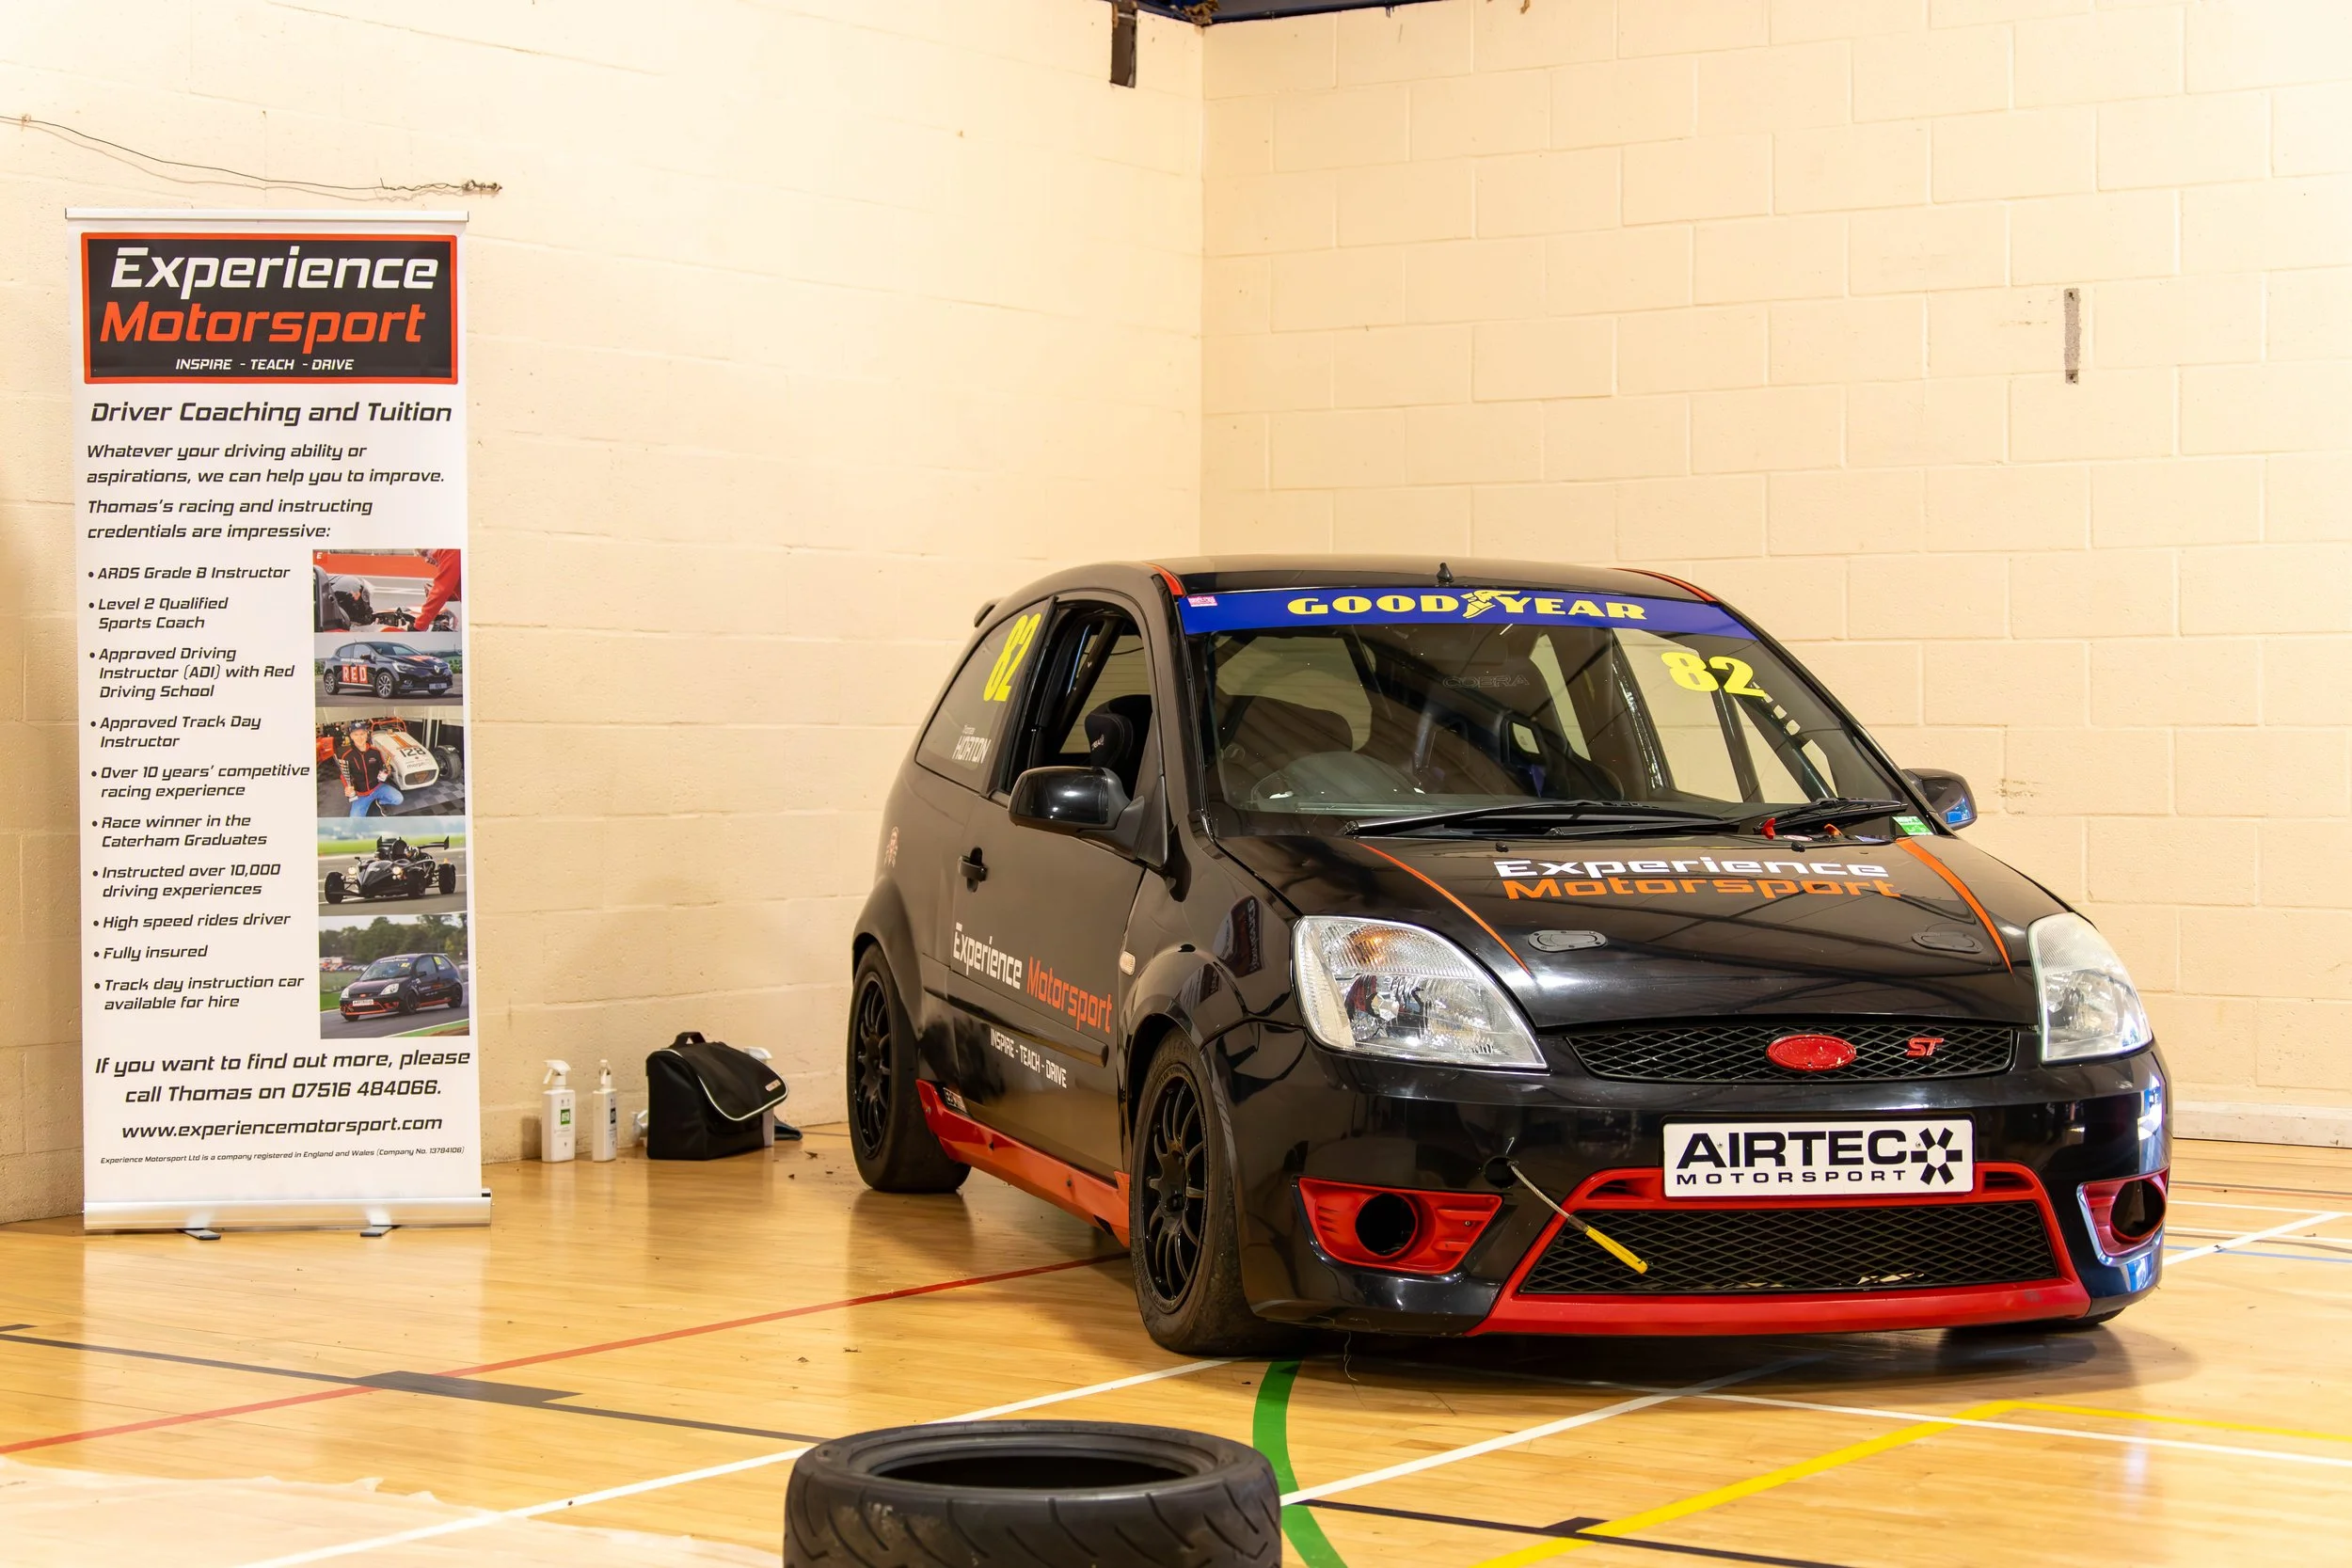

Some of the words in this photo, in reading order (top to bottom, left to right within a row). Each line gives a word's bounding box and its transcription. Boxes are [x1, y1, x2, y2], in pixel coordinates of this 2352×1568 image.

[110, 245, 438, 300] Experience
[100, 300, 426, 355] Motorsport
[175, 358, 233, 371] INSPIRE
[250, 358, 295, 371] TEACH
[311, 358, 355, 371] DRIVE
[90, 401, 173, 422] Driver
[179, 401, 302, 427] Coaching
[308, 401, 360, 421] and
[368, 401, 453, 422] Tuition
[87, 444, 174, 458] Whatever
[176, 447, 220, 461] your
[224, 443, 286, 461] driving
[290, 443, 343, 461] ability
[347, 447, 368, 457] or
[87, 468, 191, 486] aspirations,
[198, 472, 225, 483] we
[229, 472, 262, 483] can
[265, 468, 305, 486] help
[308, 472, 342, 486] you
[346, 469, 365, 483] to
[369, 467, 444, 486] improve.
[88, 499, 174, 514] Thomas’s
[178, 502, 235, 516] racing
[239, 499, 275, 513] and
[278, 499, 373, 516] instructing
[87, 524, 187, 539] credentials
[191, 528, 223, 538] are
[227, 523, 331, 542] impressive:
[97, 566, 140, 579] ARDS
[144, 565, 192, 579] Grade
[196, 566, 208, 578] B
[211, 566, 291, 578] Instructor
[98, 596, 141, 610] Level
[144, 597, 155, 610] 2
[159, 596, 229, 611] Qualified
[98, 617, 151, 633] Sports
[155, 615, 205, 628] Coach
[98, 646, 177, 663] Approved
[180, 646, 237, 662] Driving
[983, 613, 1042, 702] 82
[99, 667, 180, 679] Instructor
[183, 663, 221, 681] (ADI)
[225, 665, 260, 678] with
[263, 664, 295, 677] Red
[343, 667, 368, 682] RED
[1661, 651, 1766, 699] 82
[99, 685, 156, 701] Driving
[159, 684, 215, 698] School
[99, 715, 178, 733] Approved
[182, 715, 226, 728] Track
[230, 715, 262, 731] Day
[100, 736, 181, 748] Instructor
[951, 736, 992, 764] HORTON
[101, 767, 139, 779] Over
[143, 766, 159, 779] 10
[217, 763, 310, 780] competitive
[101, 784, 151, 800] racing
[155, 784, 246, 800] experience
[101, 816, 141, 829] Race
[146, 815, 203, 828] winner
[206, 814, 221, 828] in
[225, 814, 251, 827] the
[102, 834, 180, 847] Caterham
[183, 832, 268, 847] Graduates
[102, 864, 185, 879] Instructed
[188, 866, 227, 877] over
[230, 863, 281, 878] 10,000
[1494, 856, 1889, 879] Experience
[102, 884, 159, 900] driving
[162, 882, 262, 899] experiences
[1504, 878, 1901, 900] Motorsport
[103, 915, 139, 931] High
[142, 913, 194, 931] speed
[197, 913, 239, 927] rides
[243, 912, 292, 926] driver
[103, 946, 142, 962] Fully
[145, 944, 209, 958] insured
[104, 977, 149, 991] Track
[152, 977, 184, 993] day
[187, 975, 275, 990] instruction
[278, 977, 305, 988] car
[952, 922, 1023, 990] Experience
[1026, 956, 1113, 1034] Motorsport
[103, 996, 177, 1010] available
[180, 995, 204, 1008] for
[208, 994, 240, 1008] hire
[1906, 1037, 1946, 1058] ST
[95, 1056, 111, 1074] If
[113, 1060, 155, 1078] you
[162, 1055, 215, 1072] want
[220, 1055, 242, 1070] to
[246, 1053, 288, 1069] find
[293, 1053, 328, 1069] out
[332, 1054, 392, 1069] more,
[399, 1049, 471, 1070] please
[990, 1027, 1015, 1059] INSPIRE
[1019, 1044, 1041, 1071] TEACH
[1045, 1059, 1067, 1089] DRIVE
[125, 1085, 163, 1103] call
[168, 1085, 253, 1101] Thomas
[258, 1086, 286, 1100] on
[292, 1082, 352, 1099] 07516
[357, 1079, 441, 1097] 484066.
[121, 1117, 443, 1140] www.experiencemotorsport.com
[100, 1156, 144, 1165] Experience
[144, 1155, 187, 1164] Motorsport
[253, 1151, 294, 1161] registered
[303, 1150, 334, 1160] England
[376, 1148, 415, 1157] (Company
[1677, 1129, 1908, 1169] AIRTEC
[1677, 1169, 1907, 1186] MOTORSPORT
